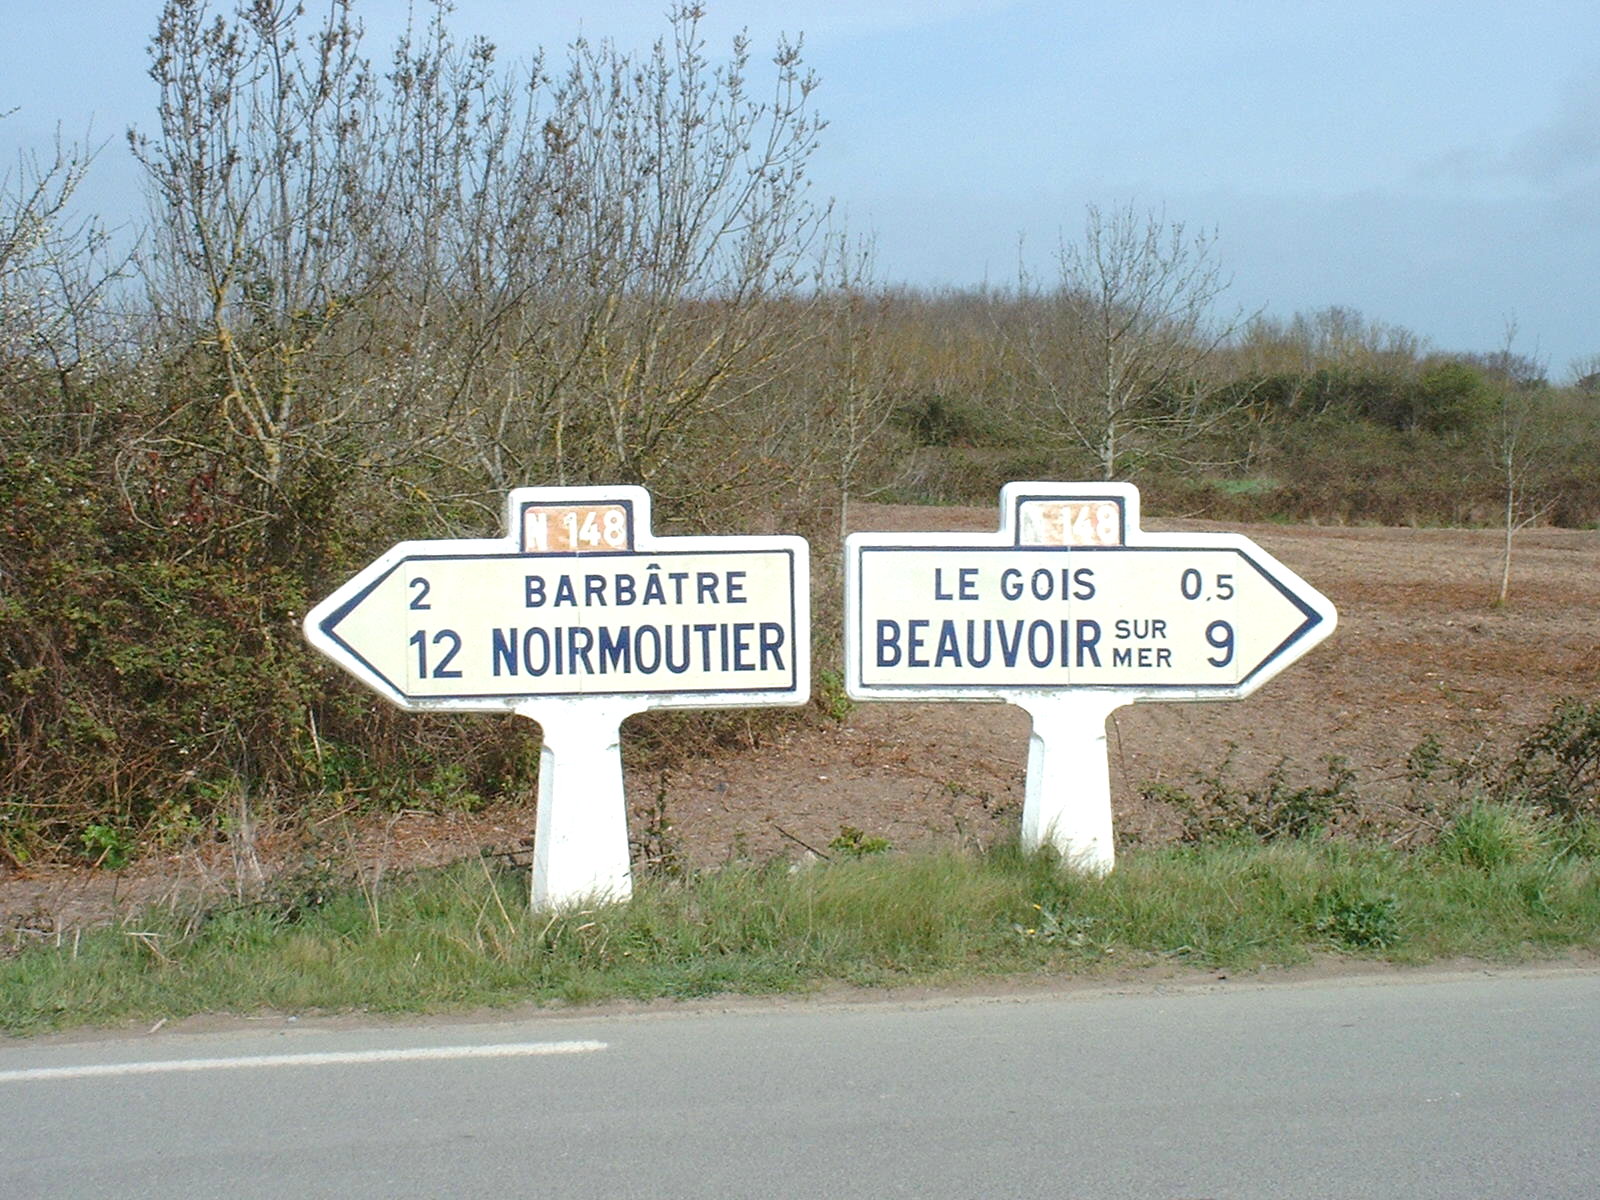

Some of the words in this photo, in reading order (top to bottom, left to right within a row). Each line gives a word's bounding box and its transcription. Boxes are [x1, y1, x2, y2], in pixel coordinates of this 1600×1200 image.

[525, 512, 548, 550] N
[563, 510, 625, 549] 148
[1060, 505, 1119, 545] 148
[409, 577, 431, 610] 2
[525, 563, 748, 609] BARBÂTRE
[935, 568, 979, 601] LE
[1000, 568, 1096, 601] GOIS
[1180, 568, 1235, 602] 0,5
[876, 619, 1102, 668] BEAUVOIR
[1114, 619, 1167, 640] SUR
[1205, 620, 1235, 668] 9
[409, 629, 463, 679] 12
[493, 622, 785, 677] NOIRMOUTIER
[1112, 648, 1172, 668] MER
